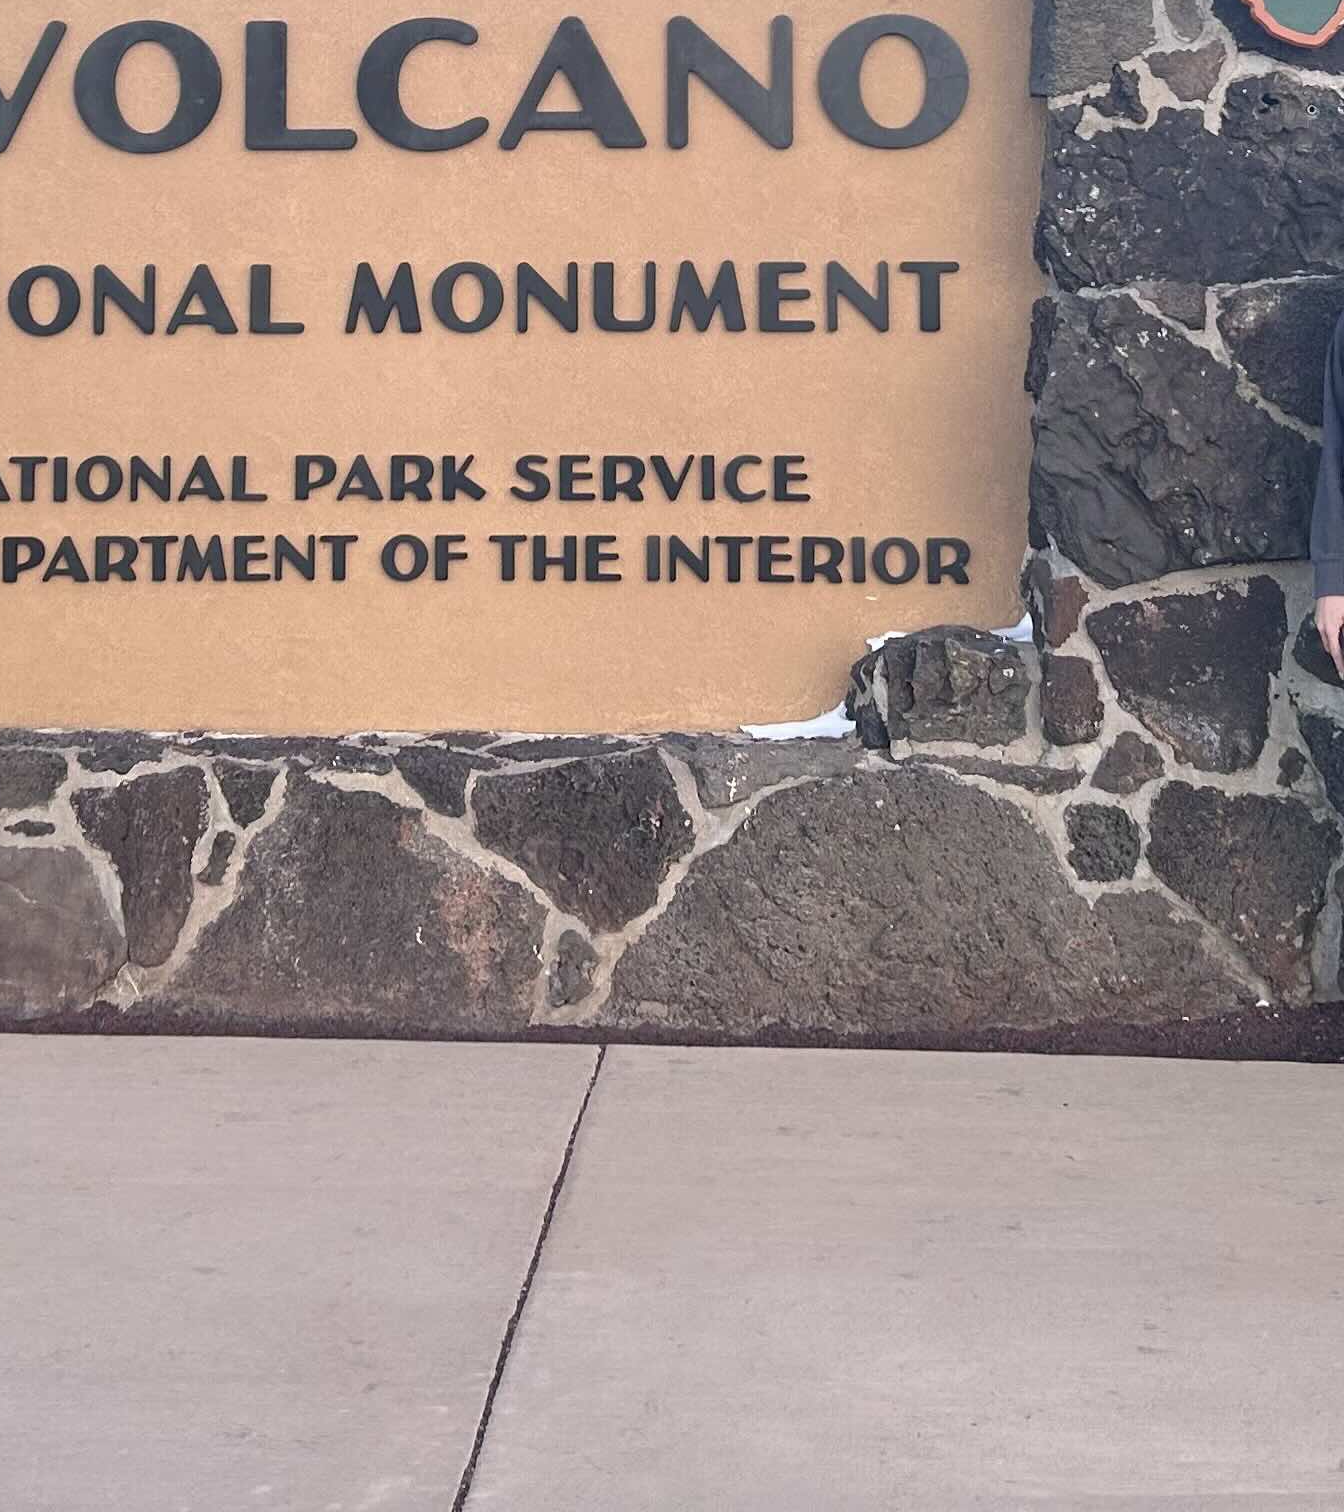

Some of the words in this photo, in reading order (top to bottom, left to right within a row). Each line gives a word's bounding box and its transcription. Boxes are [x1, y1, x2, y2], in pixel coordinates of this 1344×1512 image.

[344, 261, 960, 335] MONUMENT
[294, 454, 487, 503] PARK
[509, 454, 811, 505] SERVICE
[380, 534, 469, 583] OF
[488, 534, 623, 583] THE
[645, 534, 972, 586] INTERIOR
